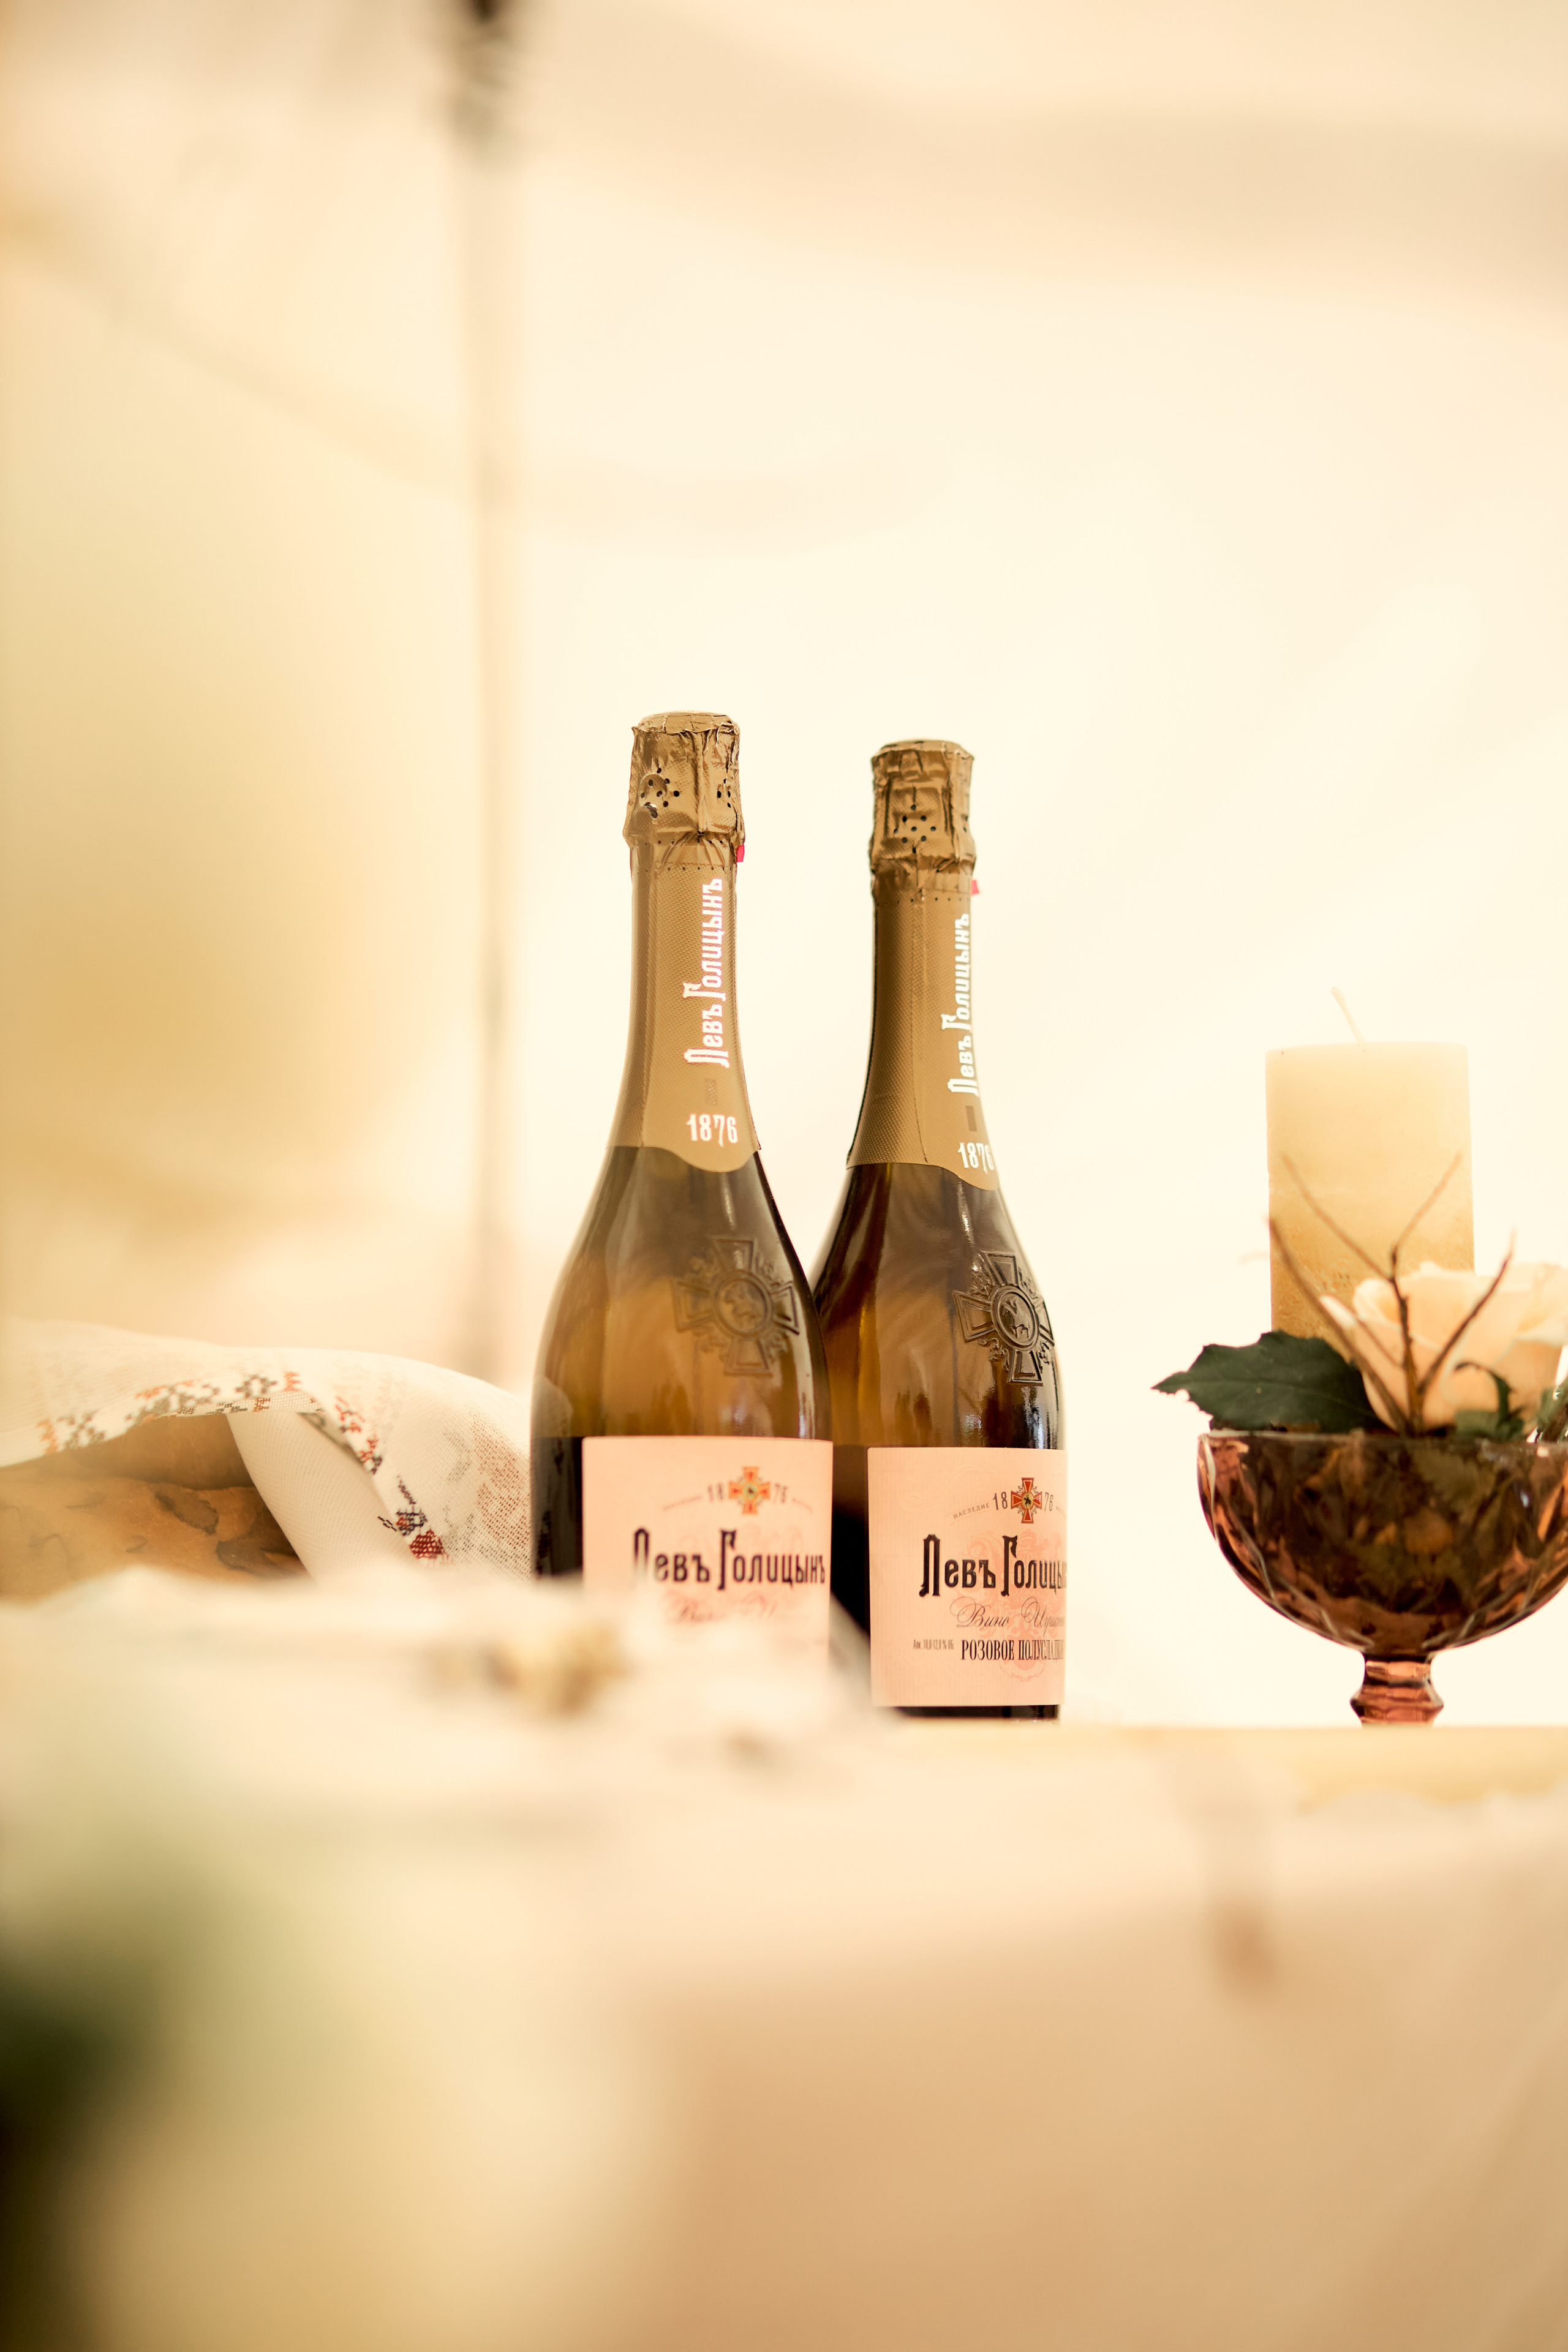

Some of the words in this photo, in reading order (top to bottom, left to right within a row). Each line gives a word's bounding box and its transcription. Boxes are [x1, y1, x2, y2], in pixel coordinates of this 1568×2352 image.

[682, 878, 726, 1001] Голицынъ
[941, 913, 972, 1033] Голицынъ
[684, 1004, 729, 1068] Левъ
[947, 1035, 979, 1097] Левъ
[686, 1114, 738, 1147] 1876
[957, 1142, 995, 1175] 1876
[952, 1502, 990, 1520] НАСЛЕДИЕ
[992, 1491, 1008, 1510] 18
[633, 1528, 710, 1588] Левъ
[717, 1529, 825, 1591] Голицынъ
[919, 1534, 996, 1597] Левъ
[949, 1596, 1010, 1630] Вино
[960, 1639, 1014, 1660] РОЗОВОЕ
